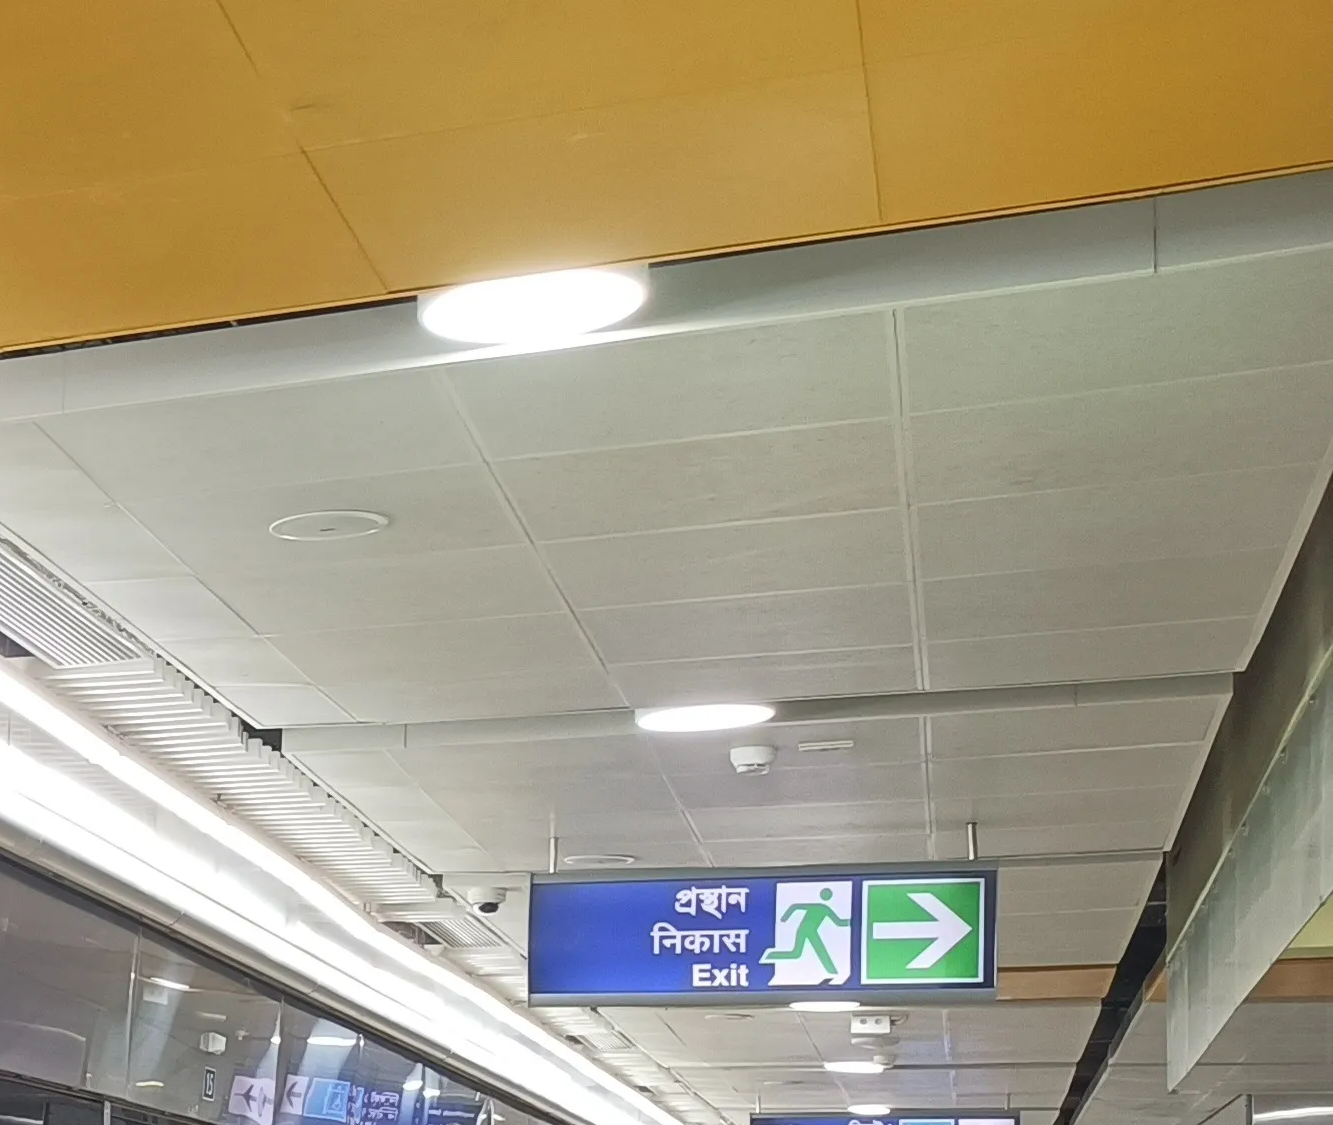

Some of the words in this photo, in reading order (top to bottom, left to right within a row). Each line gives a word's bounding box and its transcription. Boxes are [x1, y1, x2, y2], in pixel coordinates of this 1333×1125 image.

[675, 884, 750, 919] প্রস্থান
[650, 921, 750, 955] निकास
[692, 963, 749, 987] Exit
